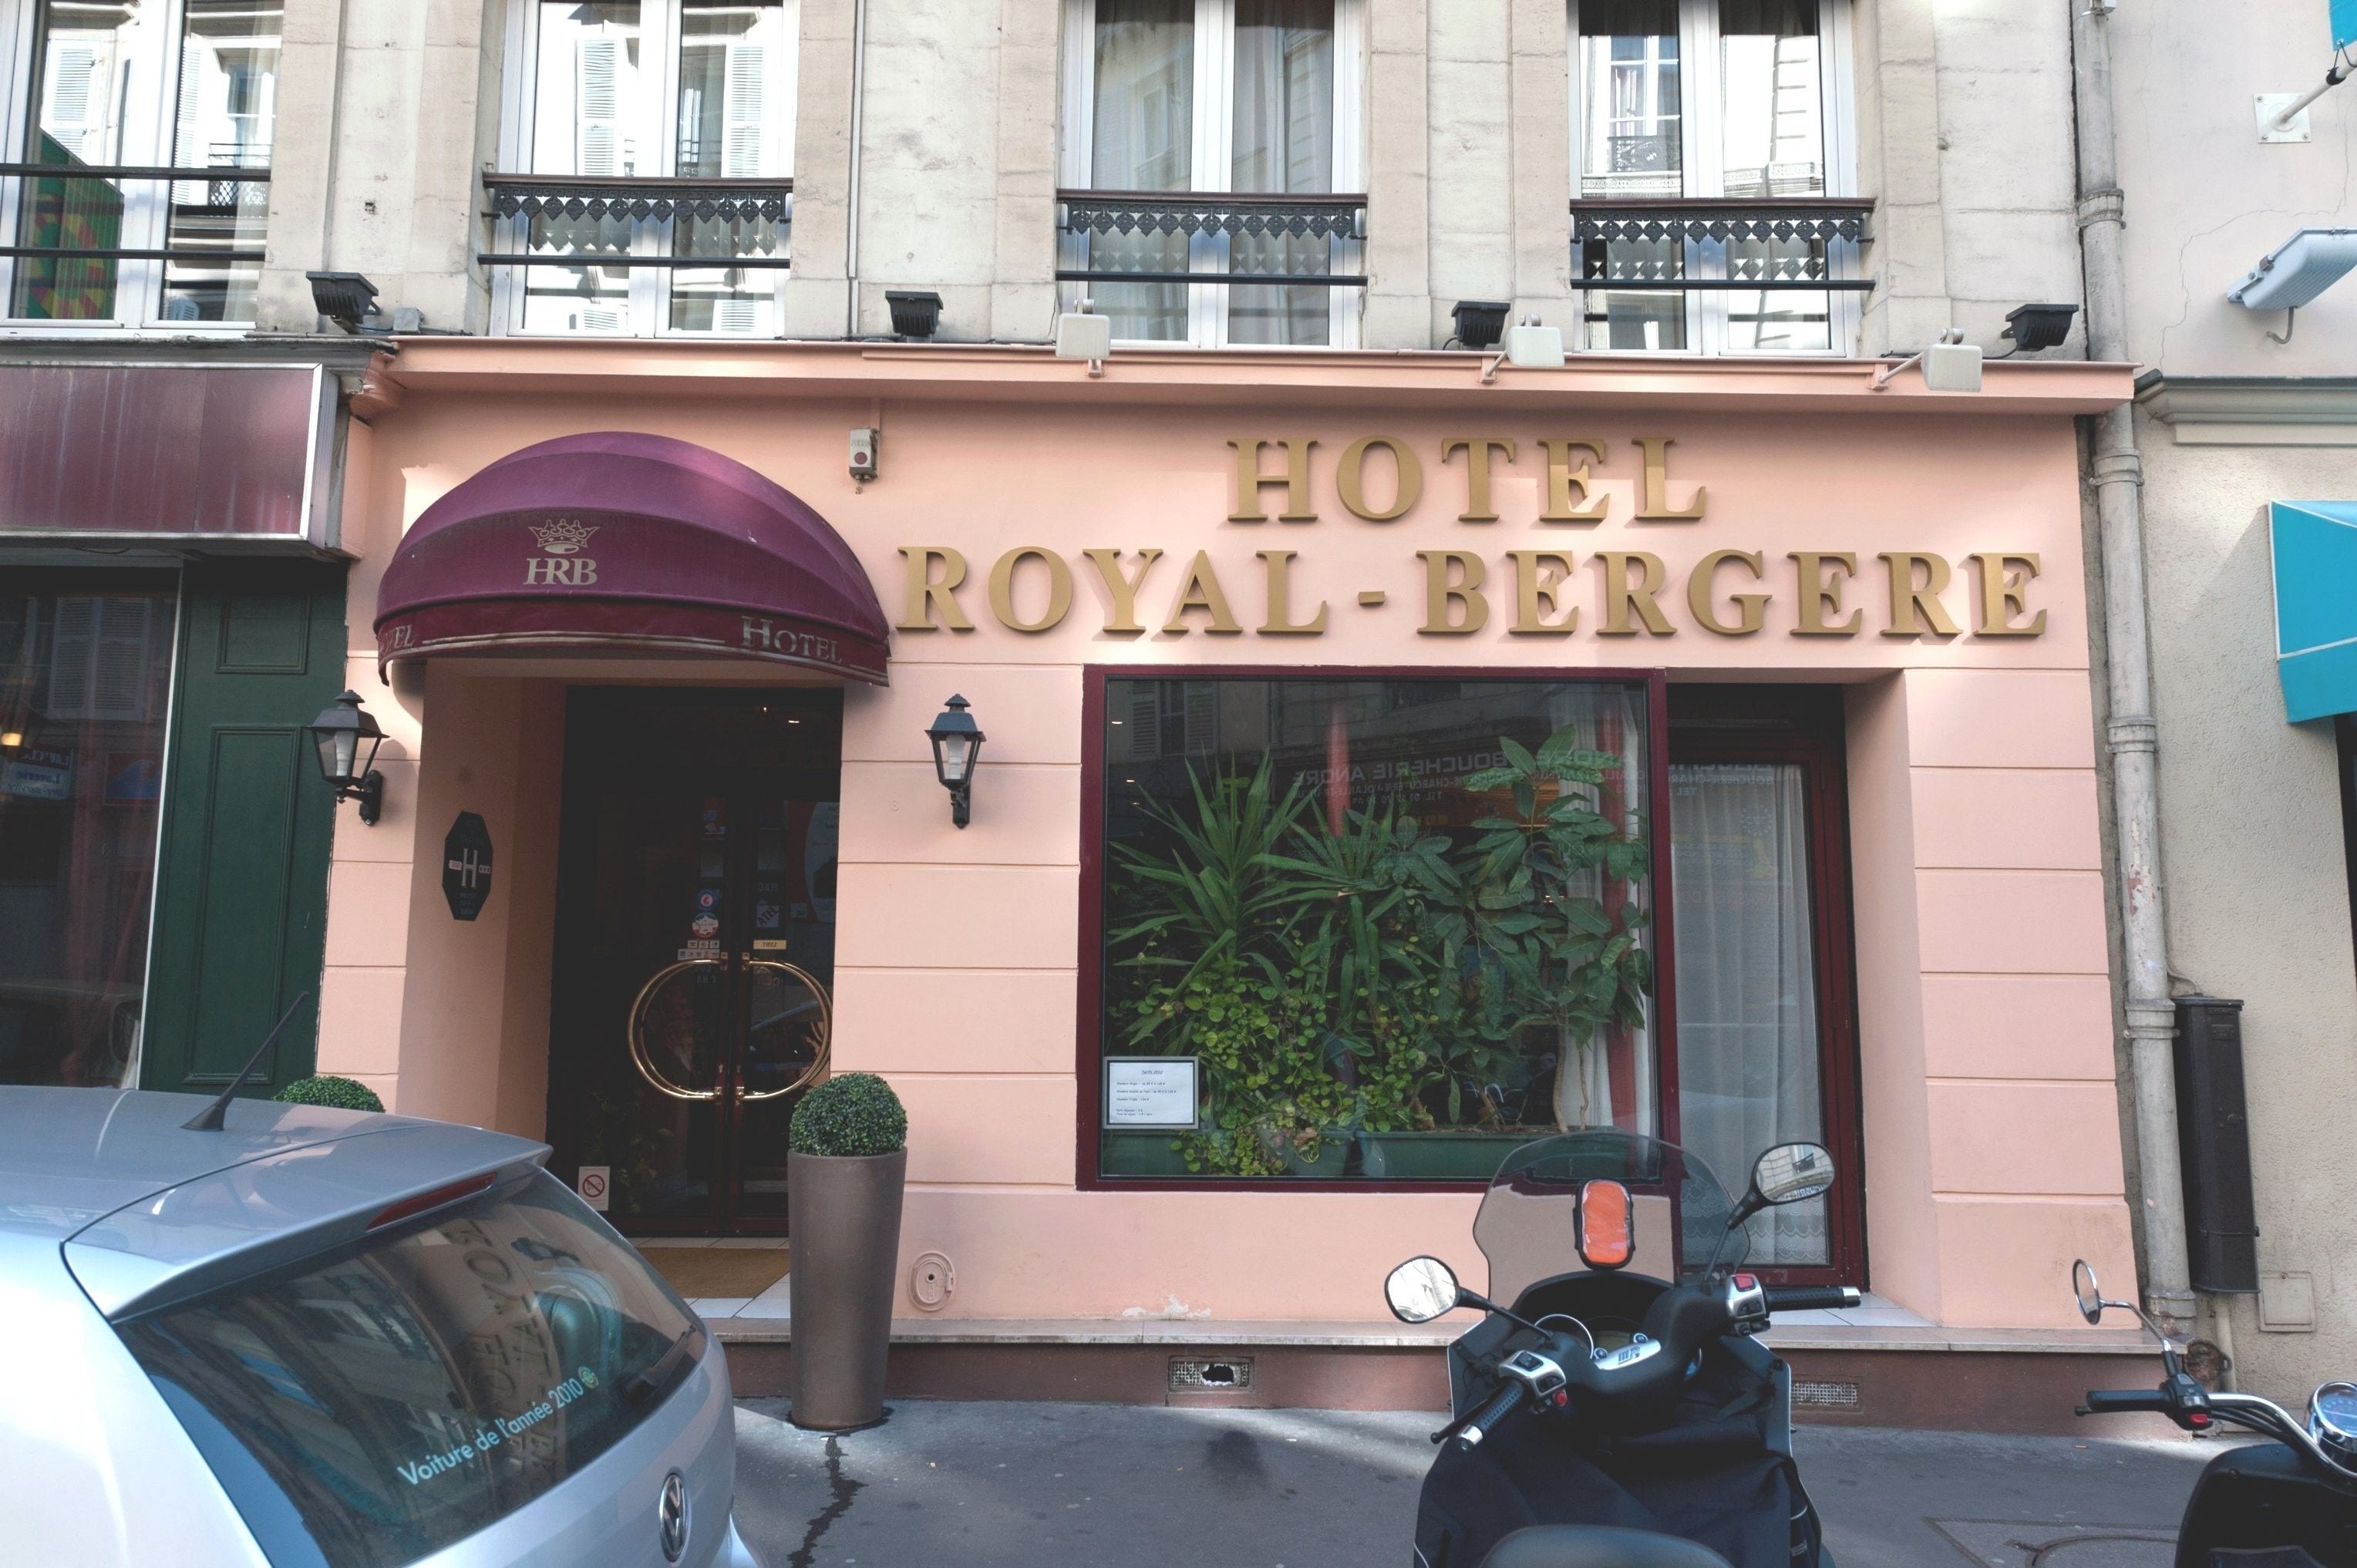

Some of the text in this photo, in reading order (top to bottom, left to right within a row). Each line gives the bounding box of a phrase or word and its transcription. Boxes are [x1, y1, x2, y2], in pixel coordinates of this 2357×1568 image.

[1227, 435, 1706, 523] HOTEL
[522, 557, 598, 586] HRB
[739, 615, 843, 665] HOTEL
[397, 1378, 584, 1486] Voiture de l'année 2010
